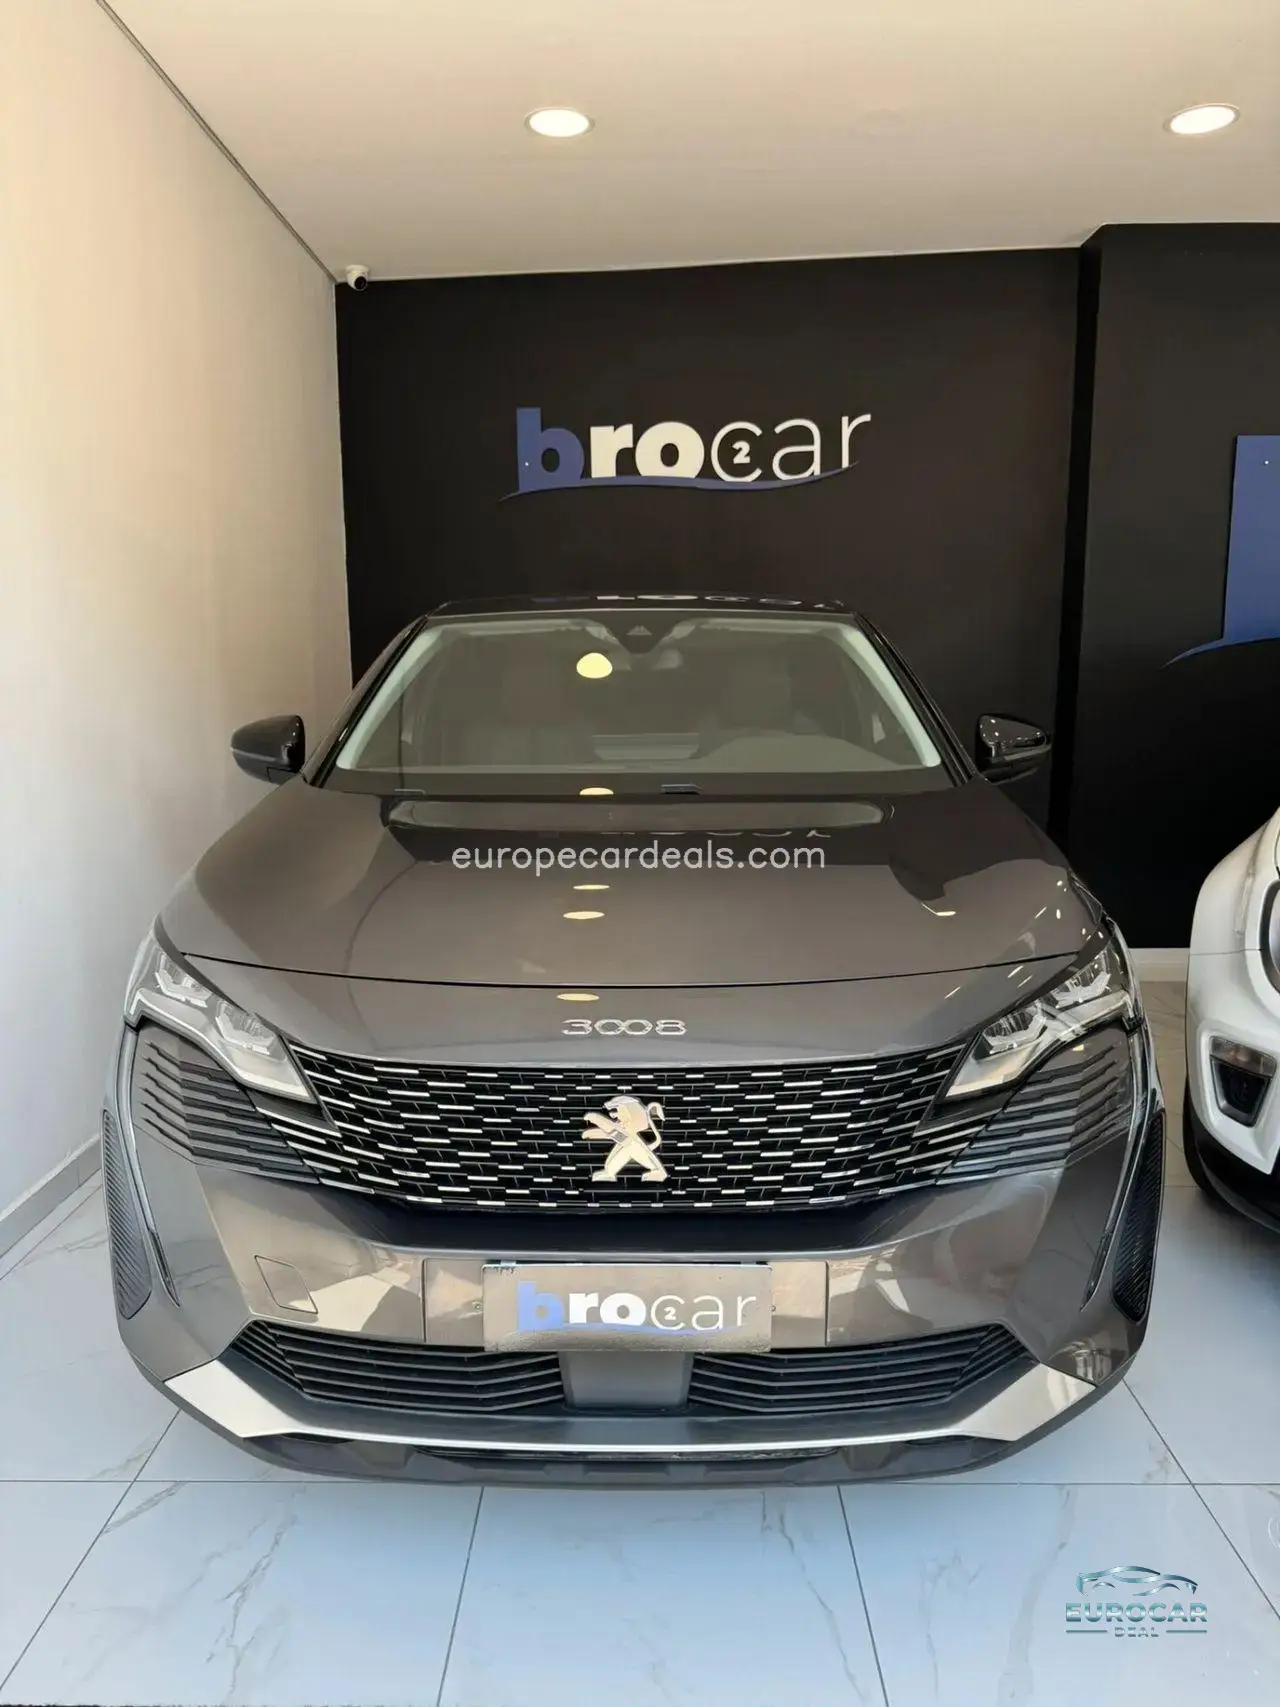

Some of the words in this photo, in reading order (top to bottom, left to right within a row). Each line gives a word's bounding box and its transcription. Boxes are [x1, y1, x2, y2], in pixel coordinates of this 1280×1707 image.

[731, 440, 752, 464] 2
[560, 1018, 687, 1035] 3008
[664, 1306, 677, 1321] 2
